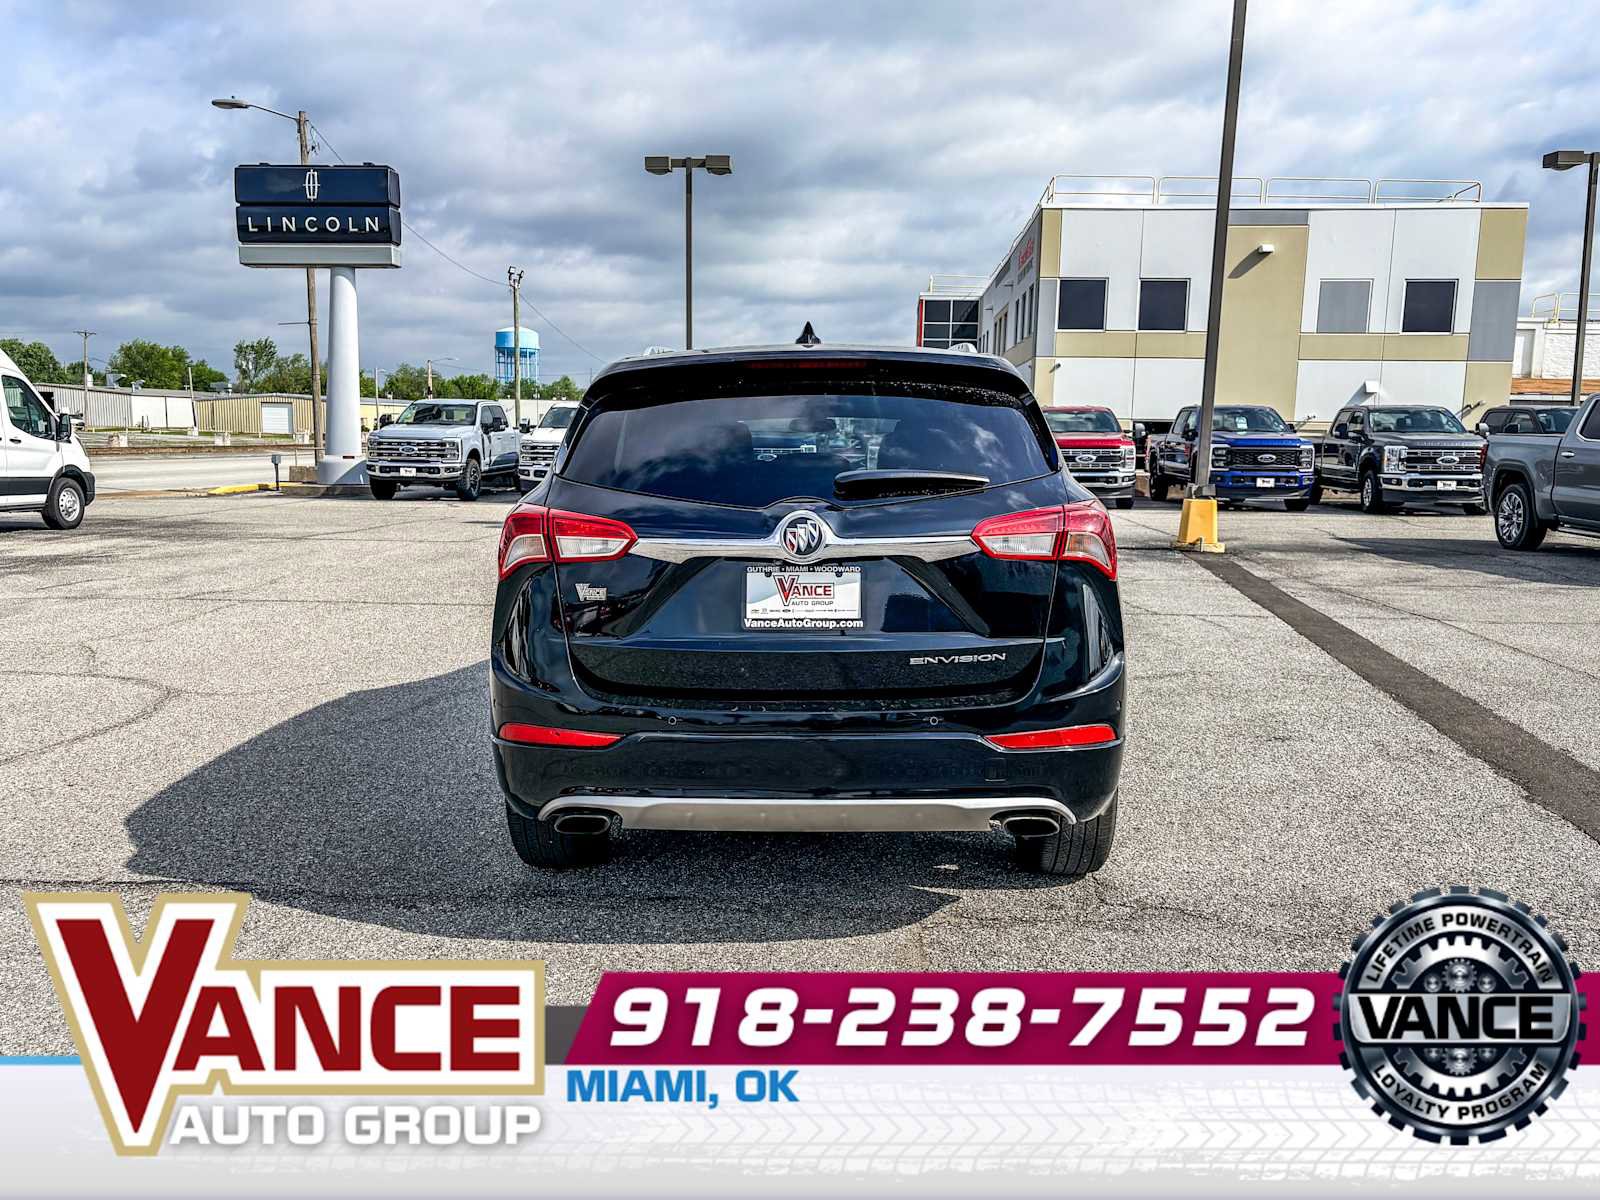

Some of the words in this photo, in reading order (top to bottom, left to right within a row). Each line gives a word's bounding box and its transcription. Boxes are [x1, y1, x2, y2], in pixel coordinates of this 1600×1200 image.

[247, 216, 379, 233] LINCOLN
[775, 576, 833, 604] VANCE
[744, 618, 864, 629] VanceAutoGroup.com
[909, 652, 1007, 665] ENVISION
